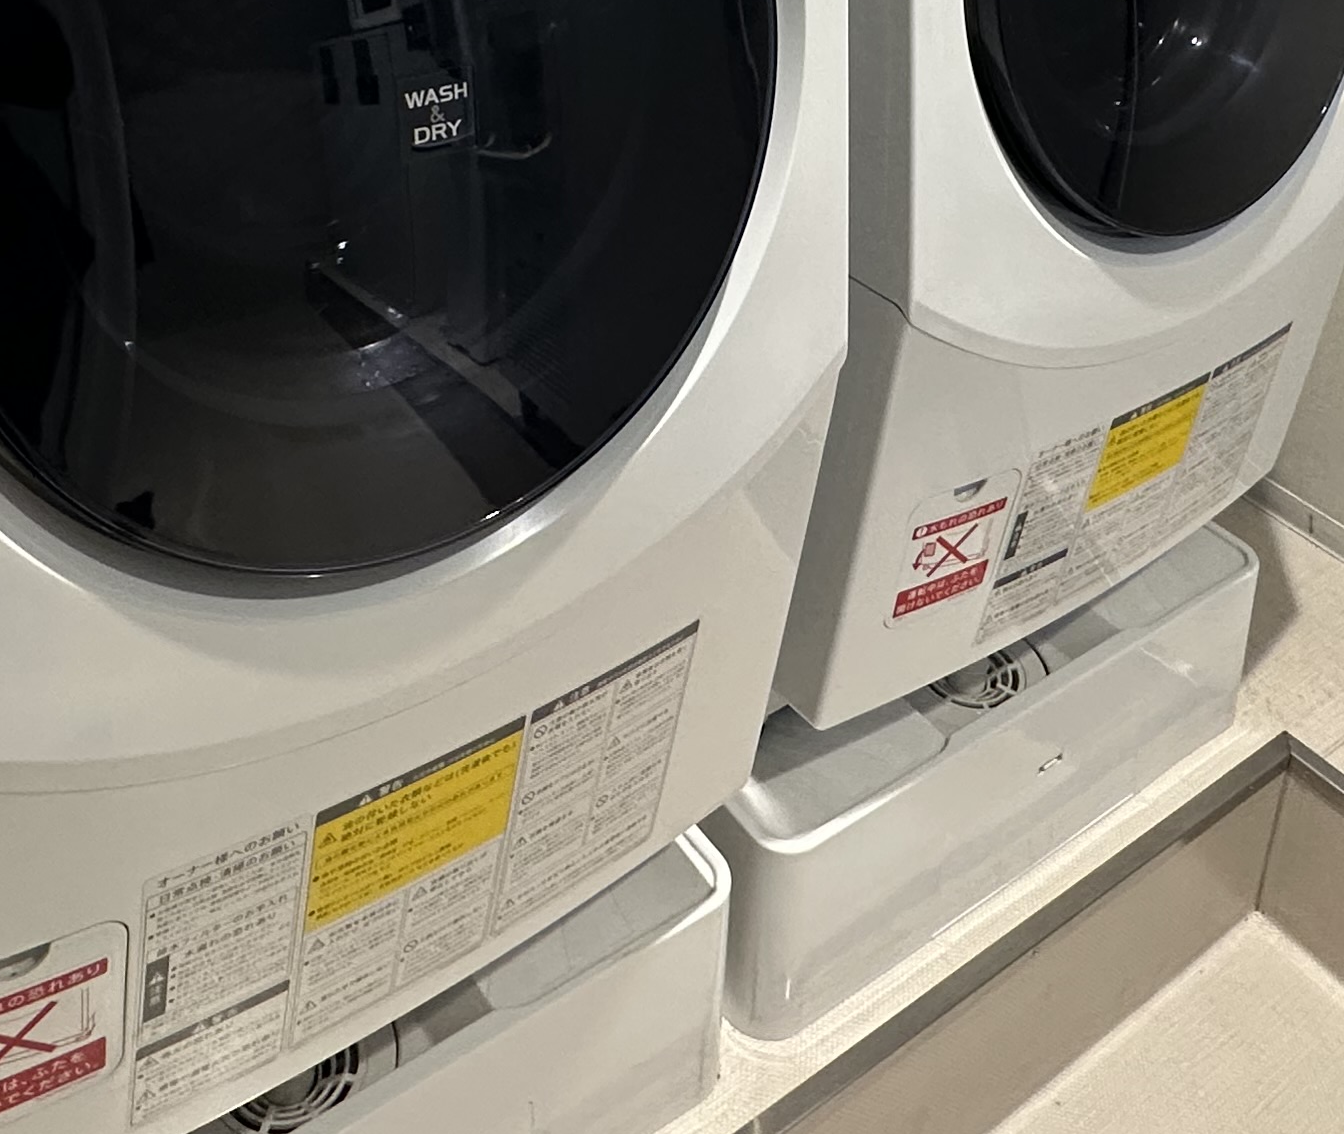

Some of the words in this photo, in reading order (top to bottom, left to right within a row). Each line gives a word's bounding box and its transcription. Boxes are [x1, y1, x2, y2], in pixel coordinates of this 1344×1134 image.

[404, 81, 468, 109] WASH
[430, 105, 445, 123] &
[413, 119, 462, 145] DRY
